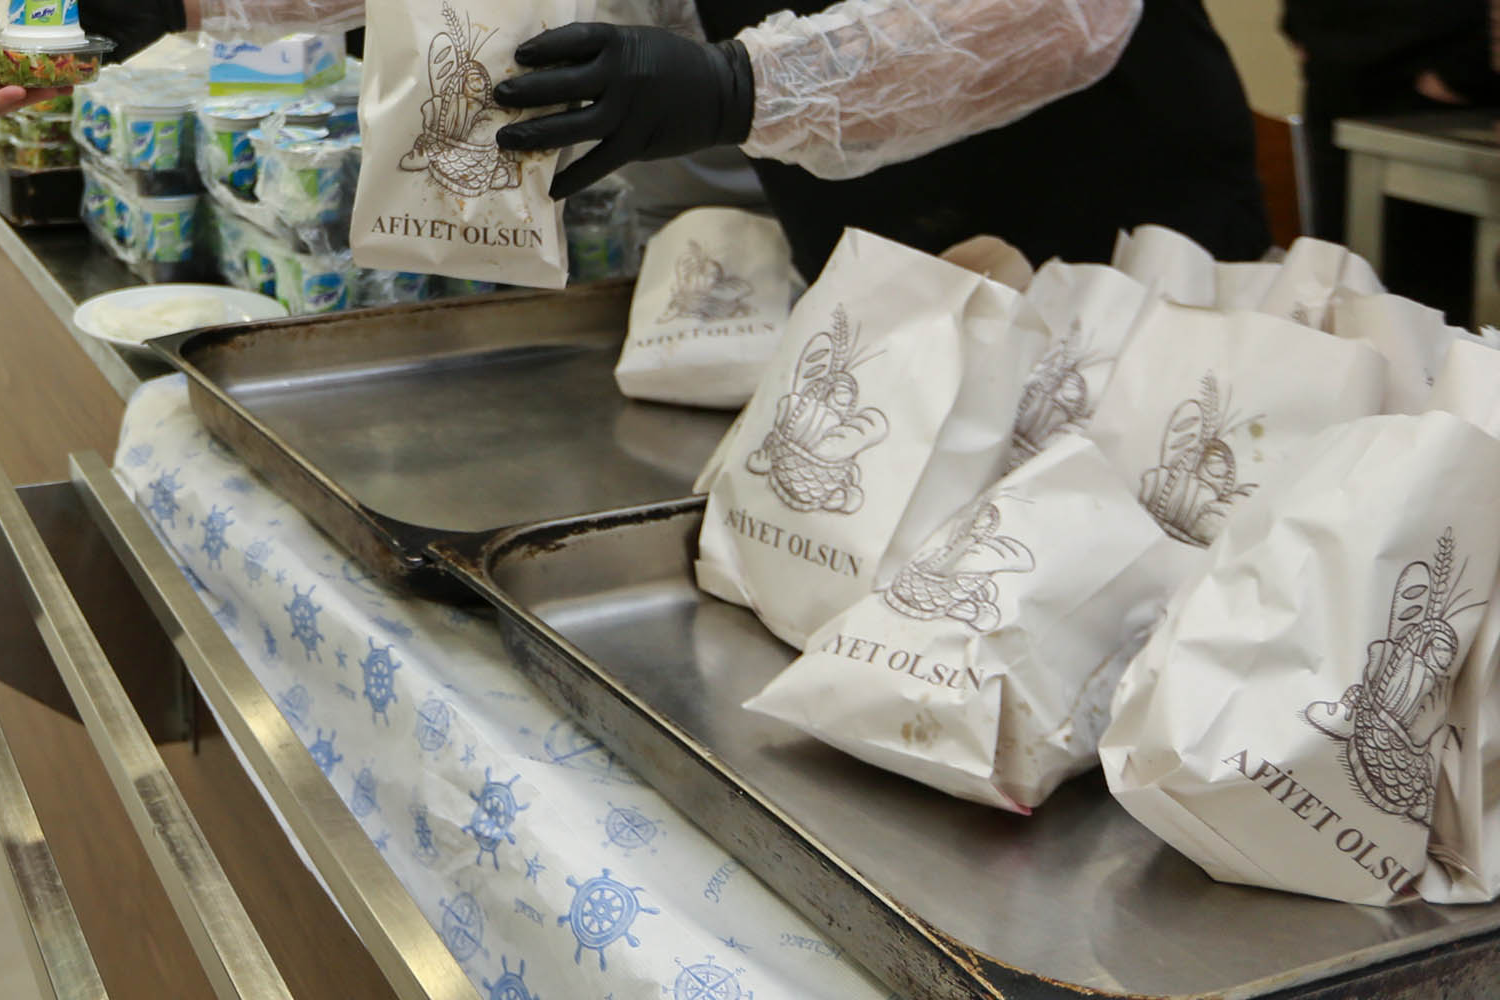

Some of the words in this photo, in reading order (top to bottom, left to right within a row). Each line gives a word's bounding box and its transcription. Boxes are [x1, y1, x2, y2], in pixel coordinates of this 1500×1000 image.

[371, 213, 458, 241] AFİYET
[462, 225, 544, 248] OLSUN
[788, 534, 863, 577] OLSUN
[1221, 749, 1343, 833] AFİYET
[1335, 827, 1415, 895] OLSU
